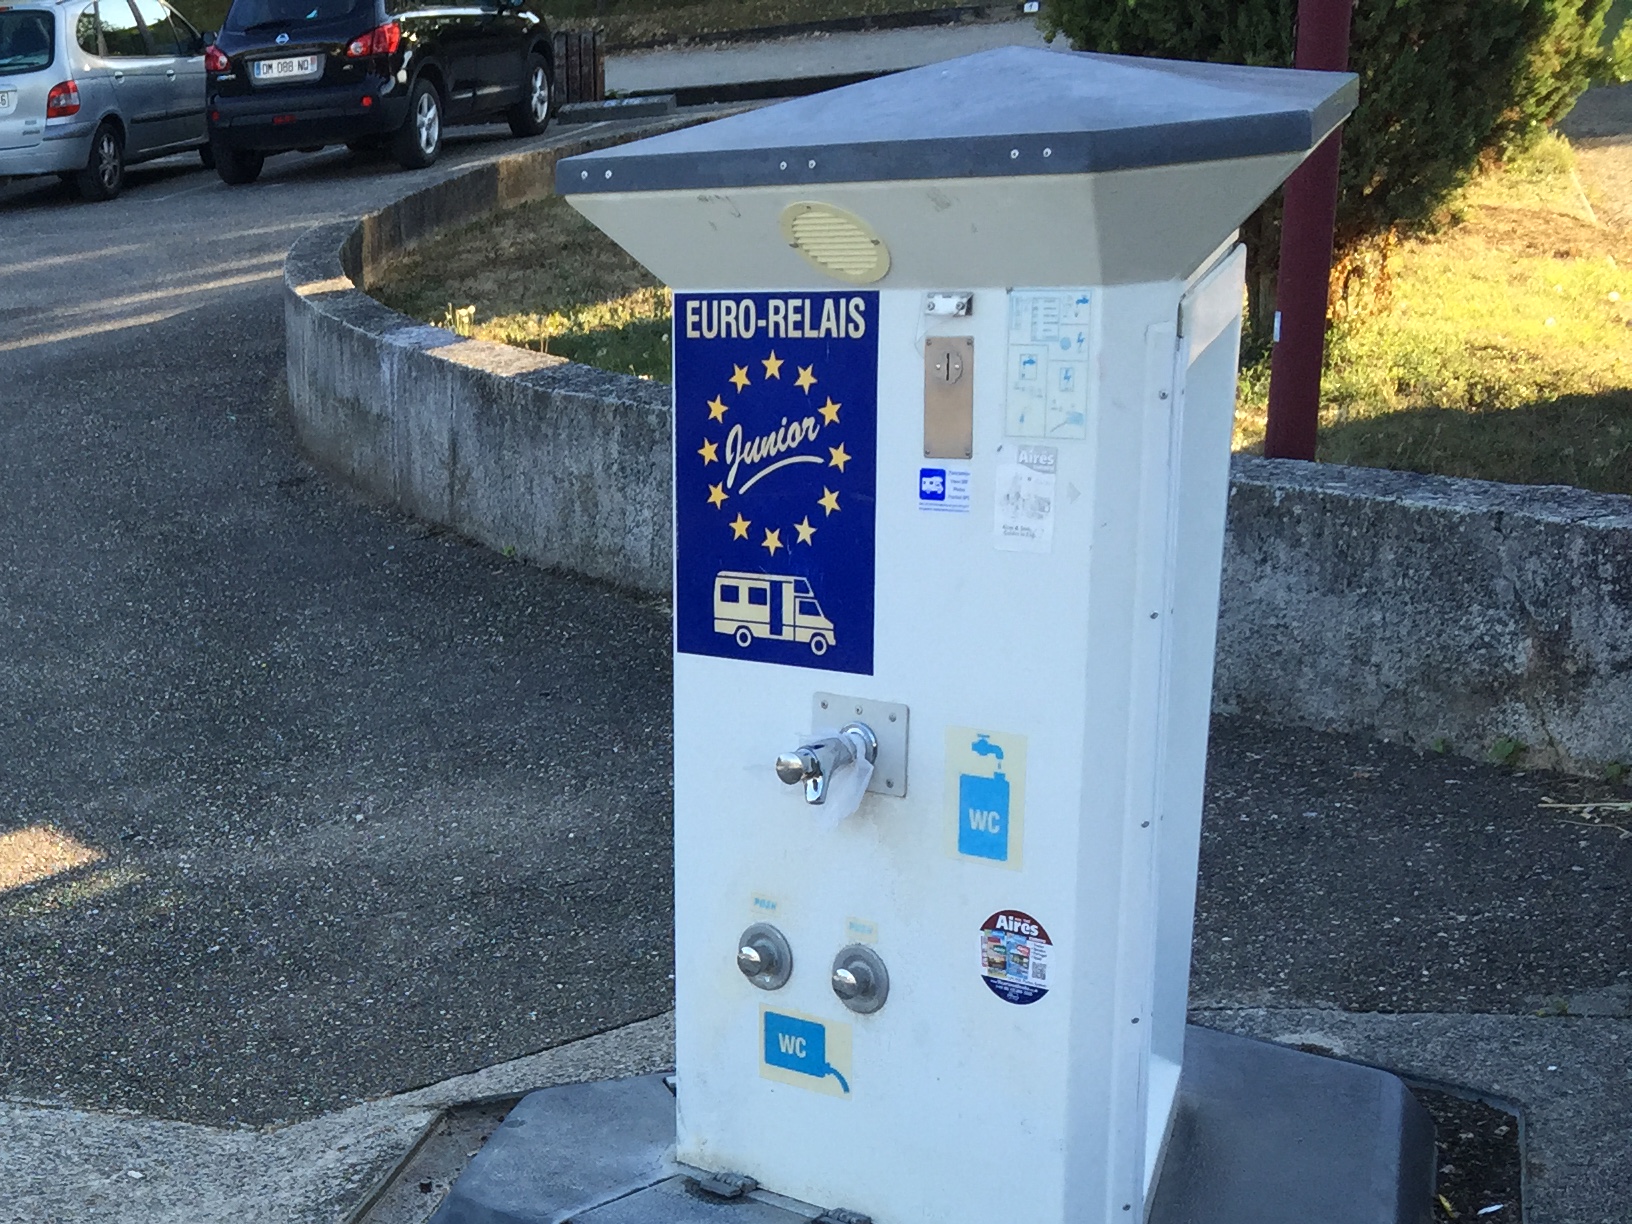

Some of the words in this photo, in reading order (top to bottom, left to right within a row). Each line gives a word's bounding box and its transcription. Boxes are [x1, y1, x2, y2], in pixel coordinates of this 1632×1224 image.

[686, 297, 866, 339] EURO-RELAIS
[725, 416, 820, 489] Junior
[1019, 449, 1055, 465] Aires
[969, 808, 1000, 834] WC
[995, 914, 1039, 937] Aires
[778, 1032, 807, 1059] WC
